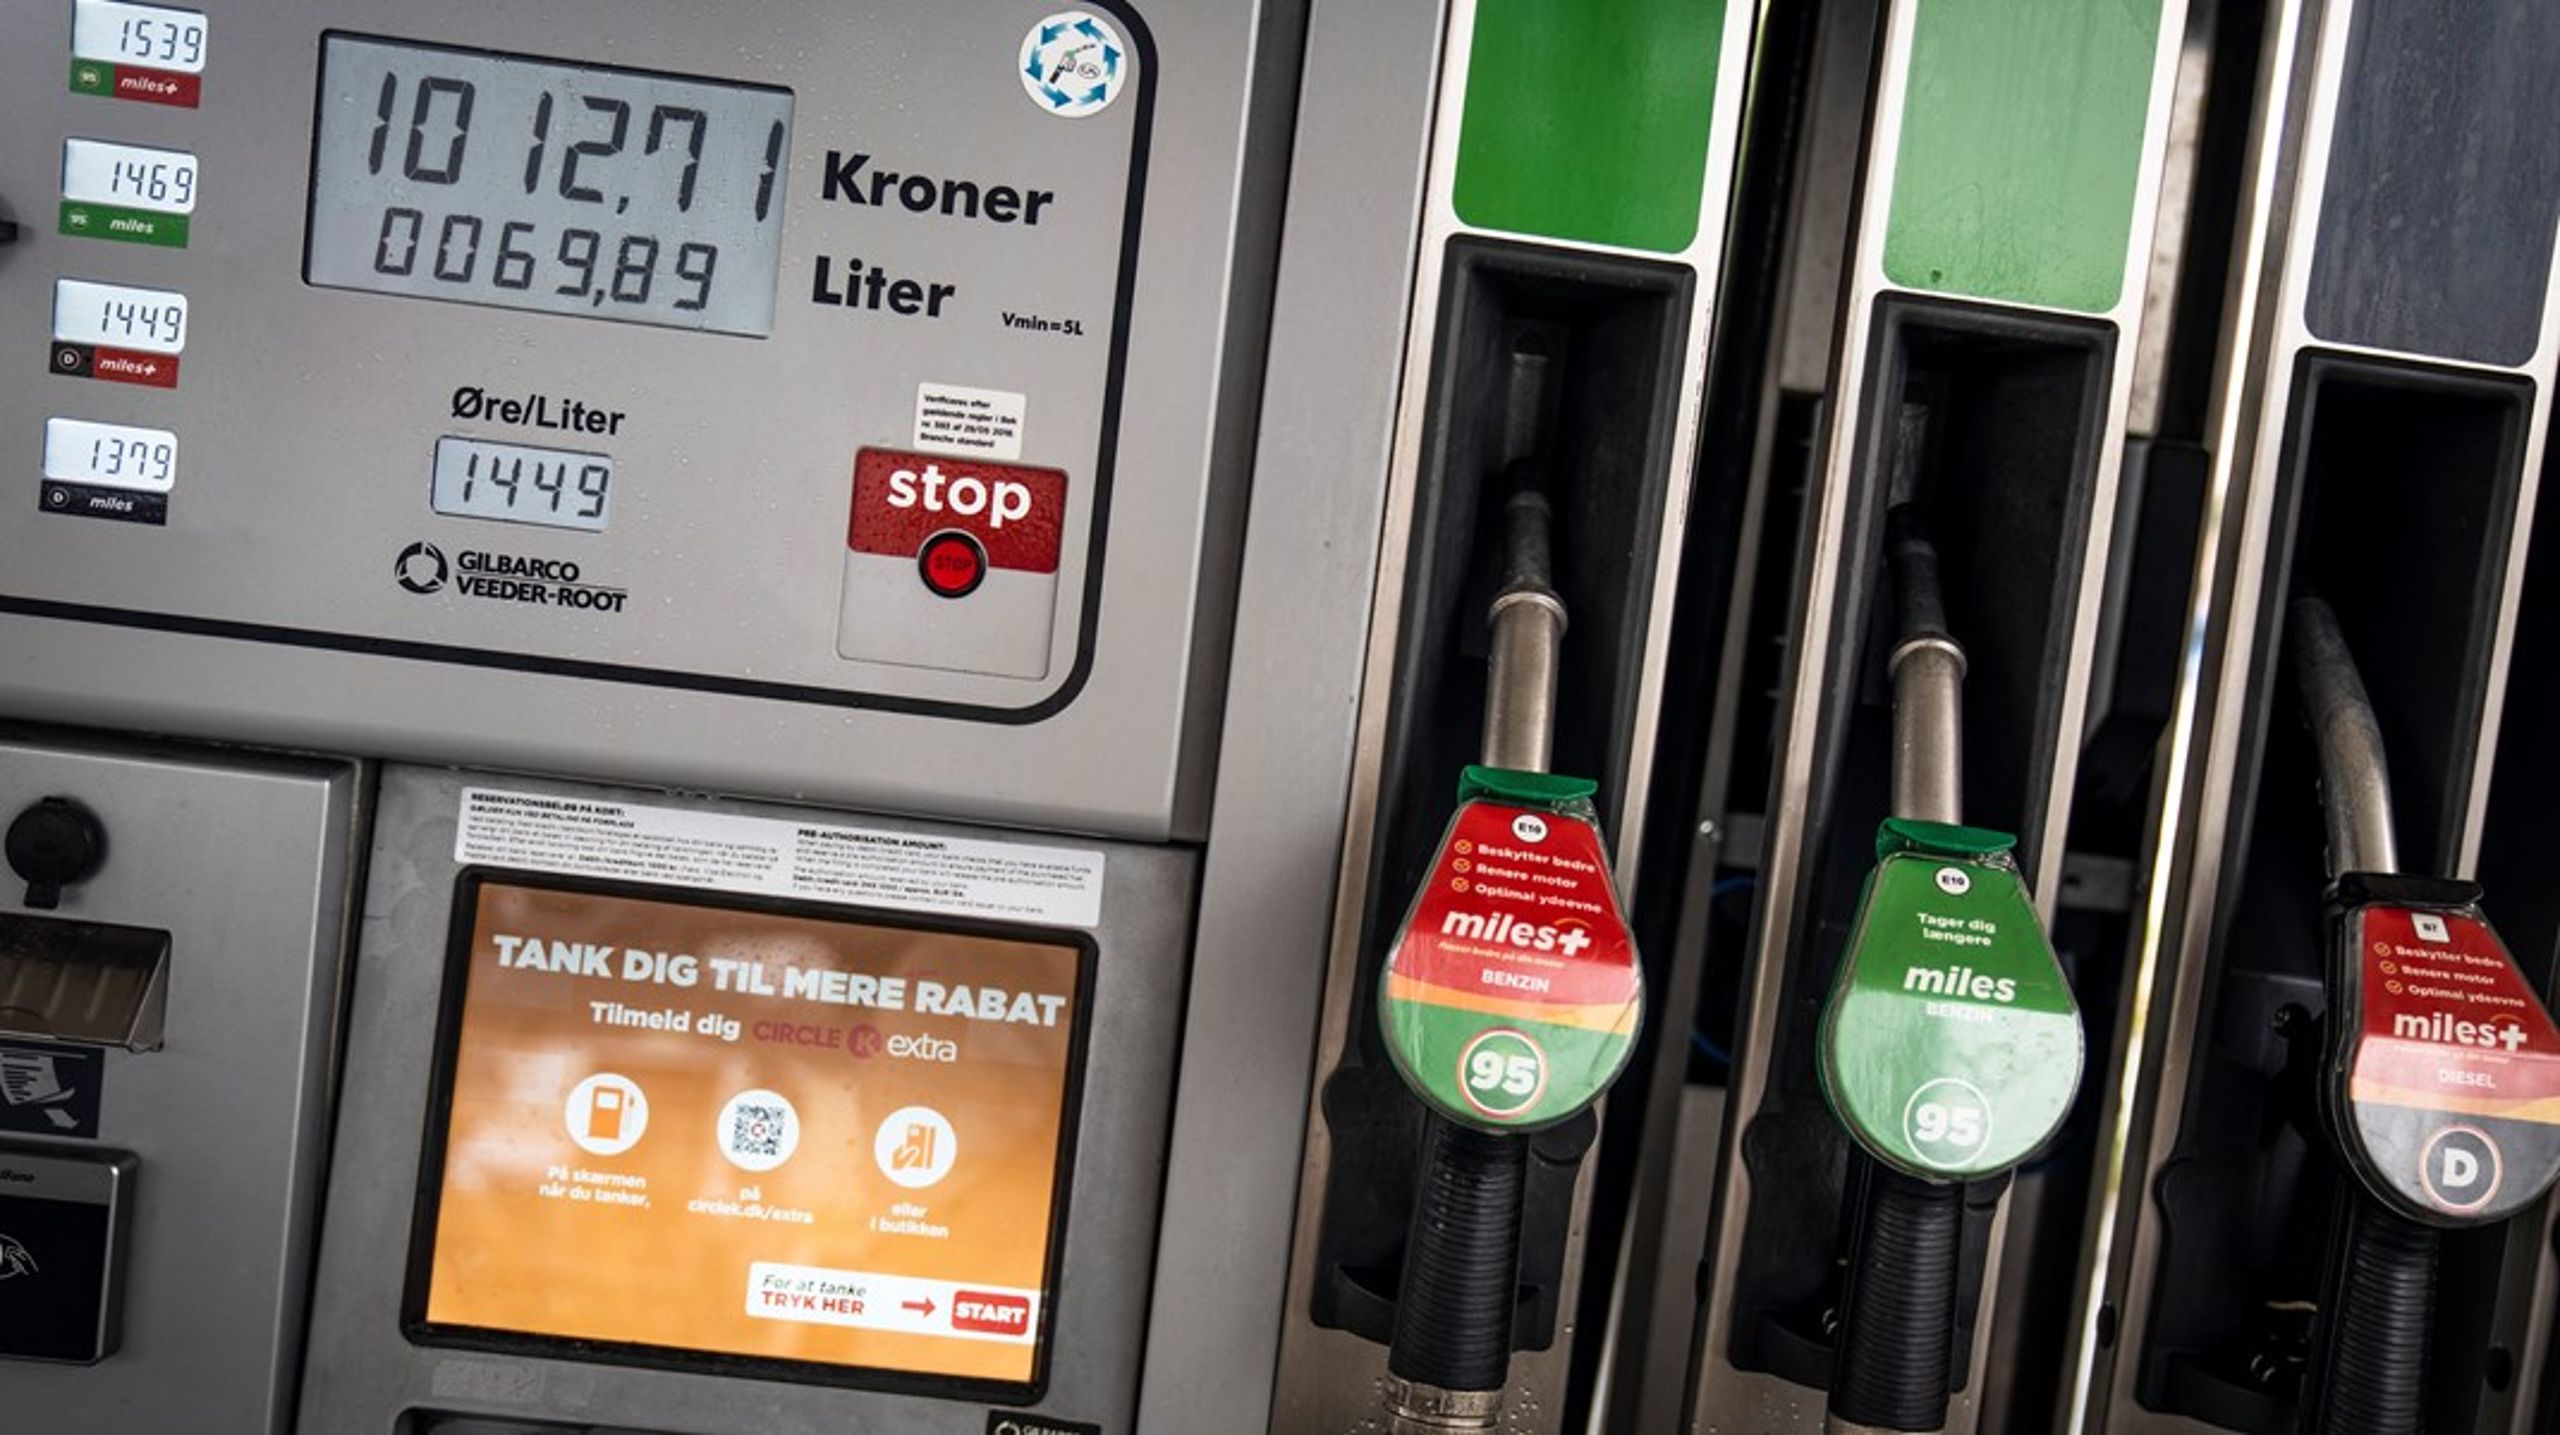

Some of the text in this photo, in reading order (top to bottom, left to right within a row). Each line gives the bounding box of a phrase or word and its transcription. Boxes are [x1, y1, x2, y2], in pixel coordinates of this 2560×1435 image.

[120, 19, 203, 63] 1539
[121, 76, 179, 95] miles+
[368, 71, 786, 222] 1012,71
[111, 161, 193, 205] 1469
[822, 150, 1054, 226] Kroner
[109, 218, 155, 235] miles
[374, 207, 719, 310] 0069,89
[812, 255, 956, 318] Liter
[101, 301, 183, 343] 1449
[1001, 312, 1084, 336] Vmin=5L
[63, 352, 157, 377] D miles+
[451, 386, 626, 436] Øre/Liter
[91, 439, 172, 480] 1379
[463, 453, 610, 518] 1449
[887, 465, 1032, 529] stop
[52, 491, 134, 512] D miles
[457, 550, 580, 583] GILBARCO
[456, 575, 628, 613] VEEDER-ROOT
[1518, 821, 1542, 836] E10
[1477, 843, 1596, 874] Beskytter bedre
[1476, 863, 1578, 890] Renere motor
[1941, 874, 1965, 886] E10
[1475, 882, 1535, 902] Optimal
[1442, 910, 1592, 957] miles+
[1917, 912, 1997, 935] Tager dig
[1922, 927, 1992, 947] længere
[2395, 944, 2504, 969] Beskytter bedre
[493, 934, 1066, 1027] TANK DIG TIL MERE RABAT
[1481, 967, 1550, 993] BENZIN
[1904, 965, 2017, 1003] miles
[2400, 964, 2495, 985] Renere motor
[2407, 984, 2465, 1001] Optimal
[1925, 1001, 1994, 1022] BENZIN
[590, 1001, 690, 1032] Tilmeld
[696, 1014, 742, 1042] dig
[752, 1019, 842, 1048] CIRCLE
[887, 1033, 958, 1062] extra
[2393, 1011, 2528, 1051] miles+
[1469, 1049, 1538, 1096] 95
[2438, 1067, 2497, 1090] DIESEL
[1914, 1103, 1981, 1147] 95
[548, 1165, 647, 1190] På skærmen
[2442, 1147, 2479, 1187] D
[539, 1181, 567, 1197] når
[569, 1185, 592, 1200] du
[740, 1184, 762, 1202] på
[688, 1198, 814, 1225] circlek.dk/extra
[891, 1202, 928, 1218] eller
[879, 1218, 949, 1239] butikken
[762, 1274, 867, 1298] For at tanke
[761, 1290, 865, 1316] TRYK HER
[955, 1302, 1026, 1325] START
